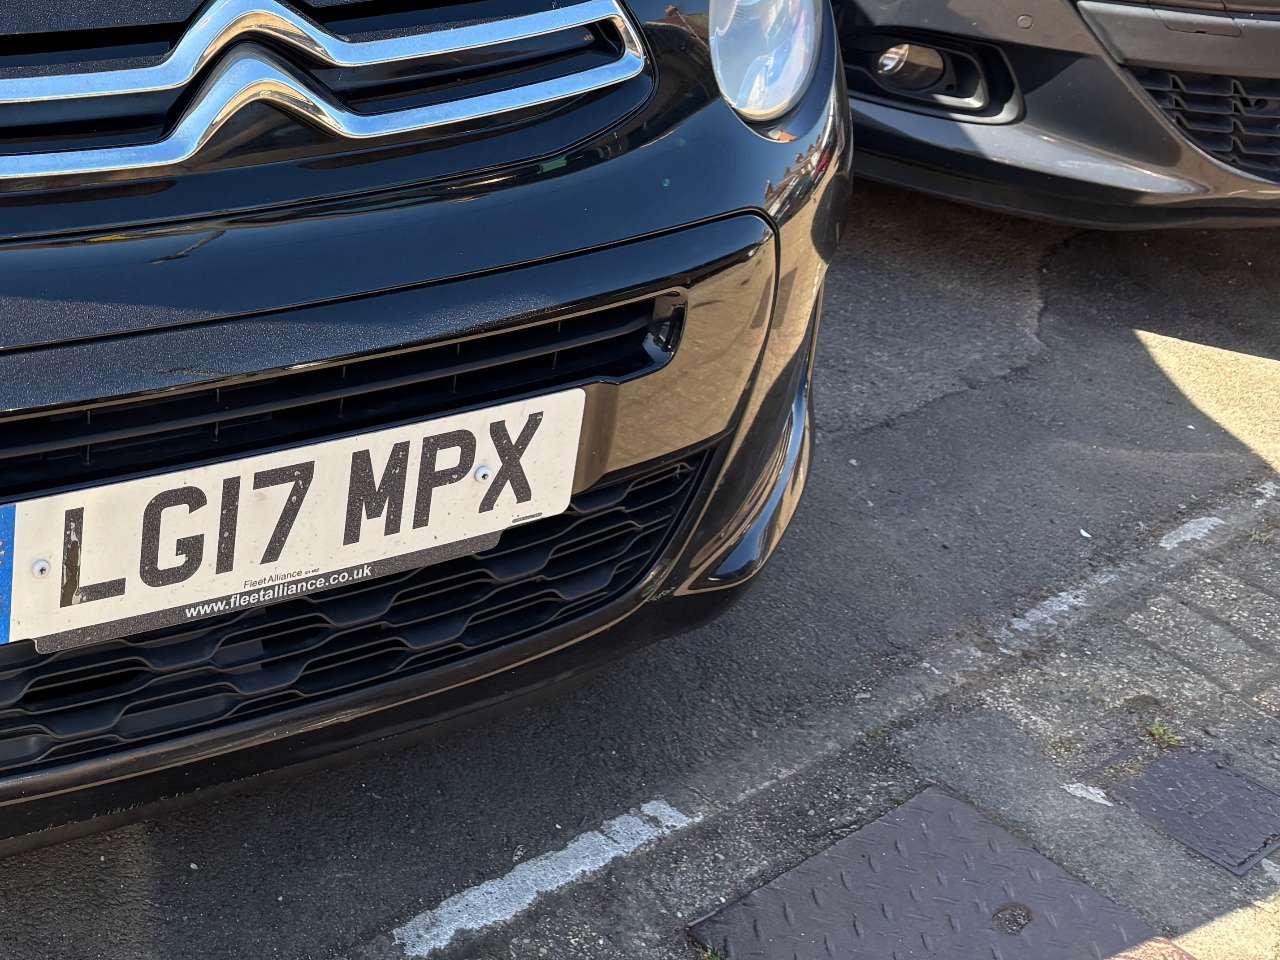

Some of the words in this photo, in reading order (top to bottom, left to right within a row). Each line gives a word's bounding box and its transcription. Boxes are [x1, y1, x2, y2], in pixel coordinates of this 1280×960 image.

[59, 462, 314, 609] LG17
[342, 411, 544, 547] MPX
[185, 564, 372, 618] www.fleetalliance.co.uk
